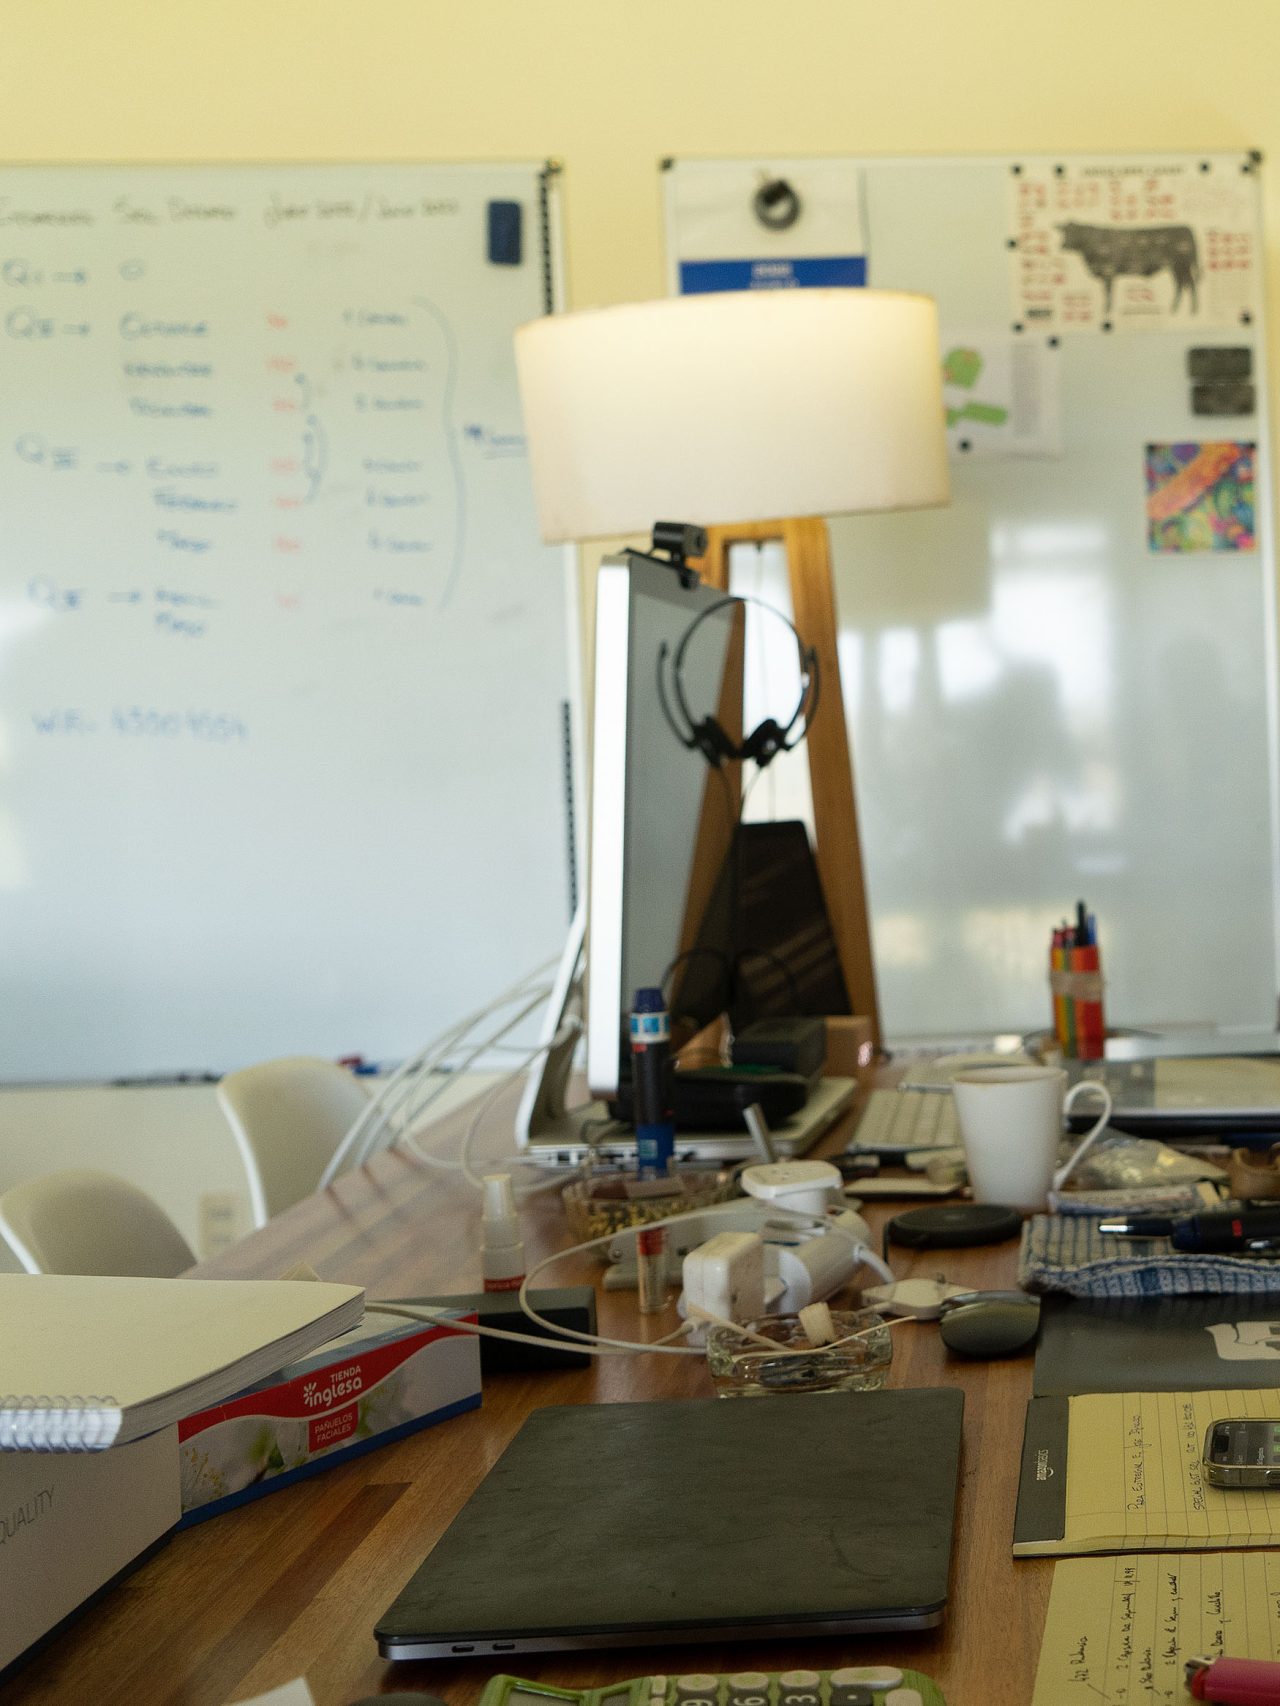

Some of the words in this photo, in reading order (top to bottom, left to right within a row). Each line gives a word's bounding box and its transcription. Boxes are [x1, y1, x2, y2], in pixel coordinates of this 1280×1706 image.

[330, 1365, 362, 1383] TIENDA
[303, 1376, 363, 1408] inglesa
[314, 1412, 353, 1434] PAÑUELOS
[317, 1423, 352, 1443] FACIALES
